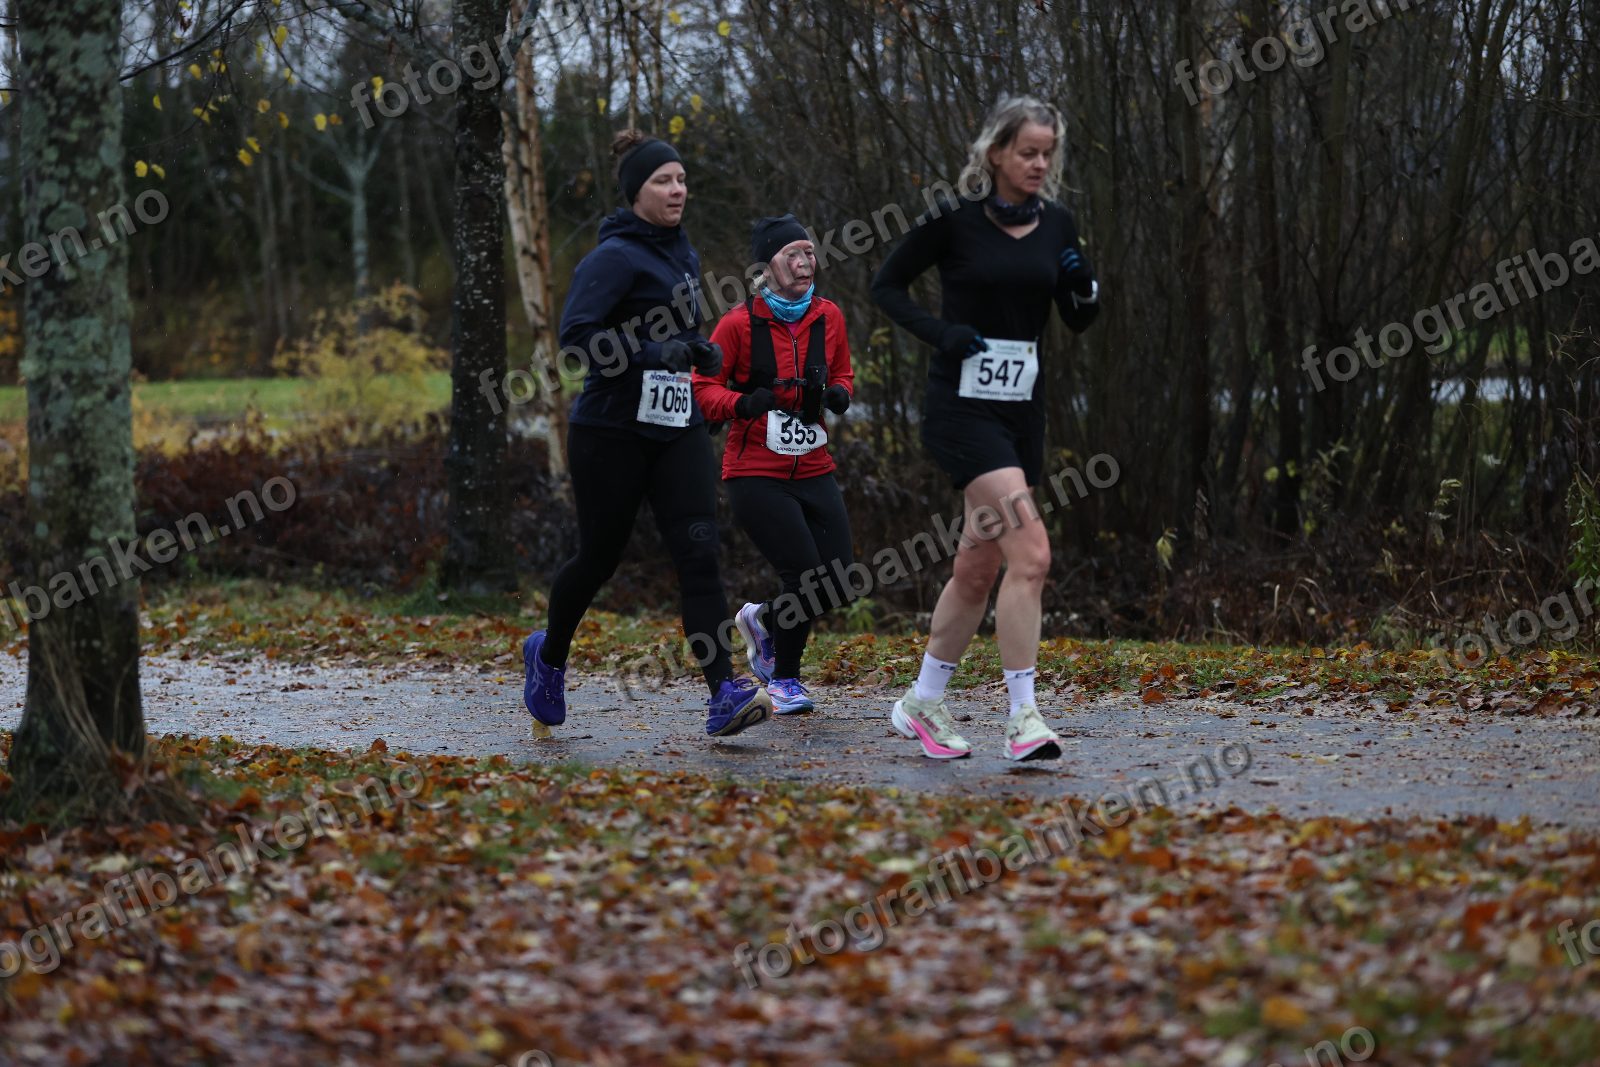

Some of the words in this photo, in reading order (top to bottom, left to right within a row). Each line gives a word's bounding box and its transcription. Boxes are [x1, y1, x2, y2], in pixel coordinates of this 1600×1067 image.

[978, 358, 1025, 388] 547
[650, 385, 688, 414] 1066
[780, 417, 817, 445] 555
